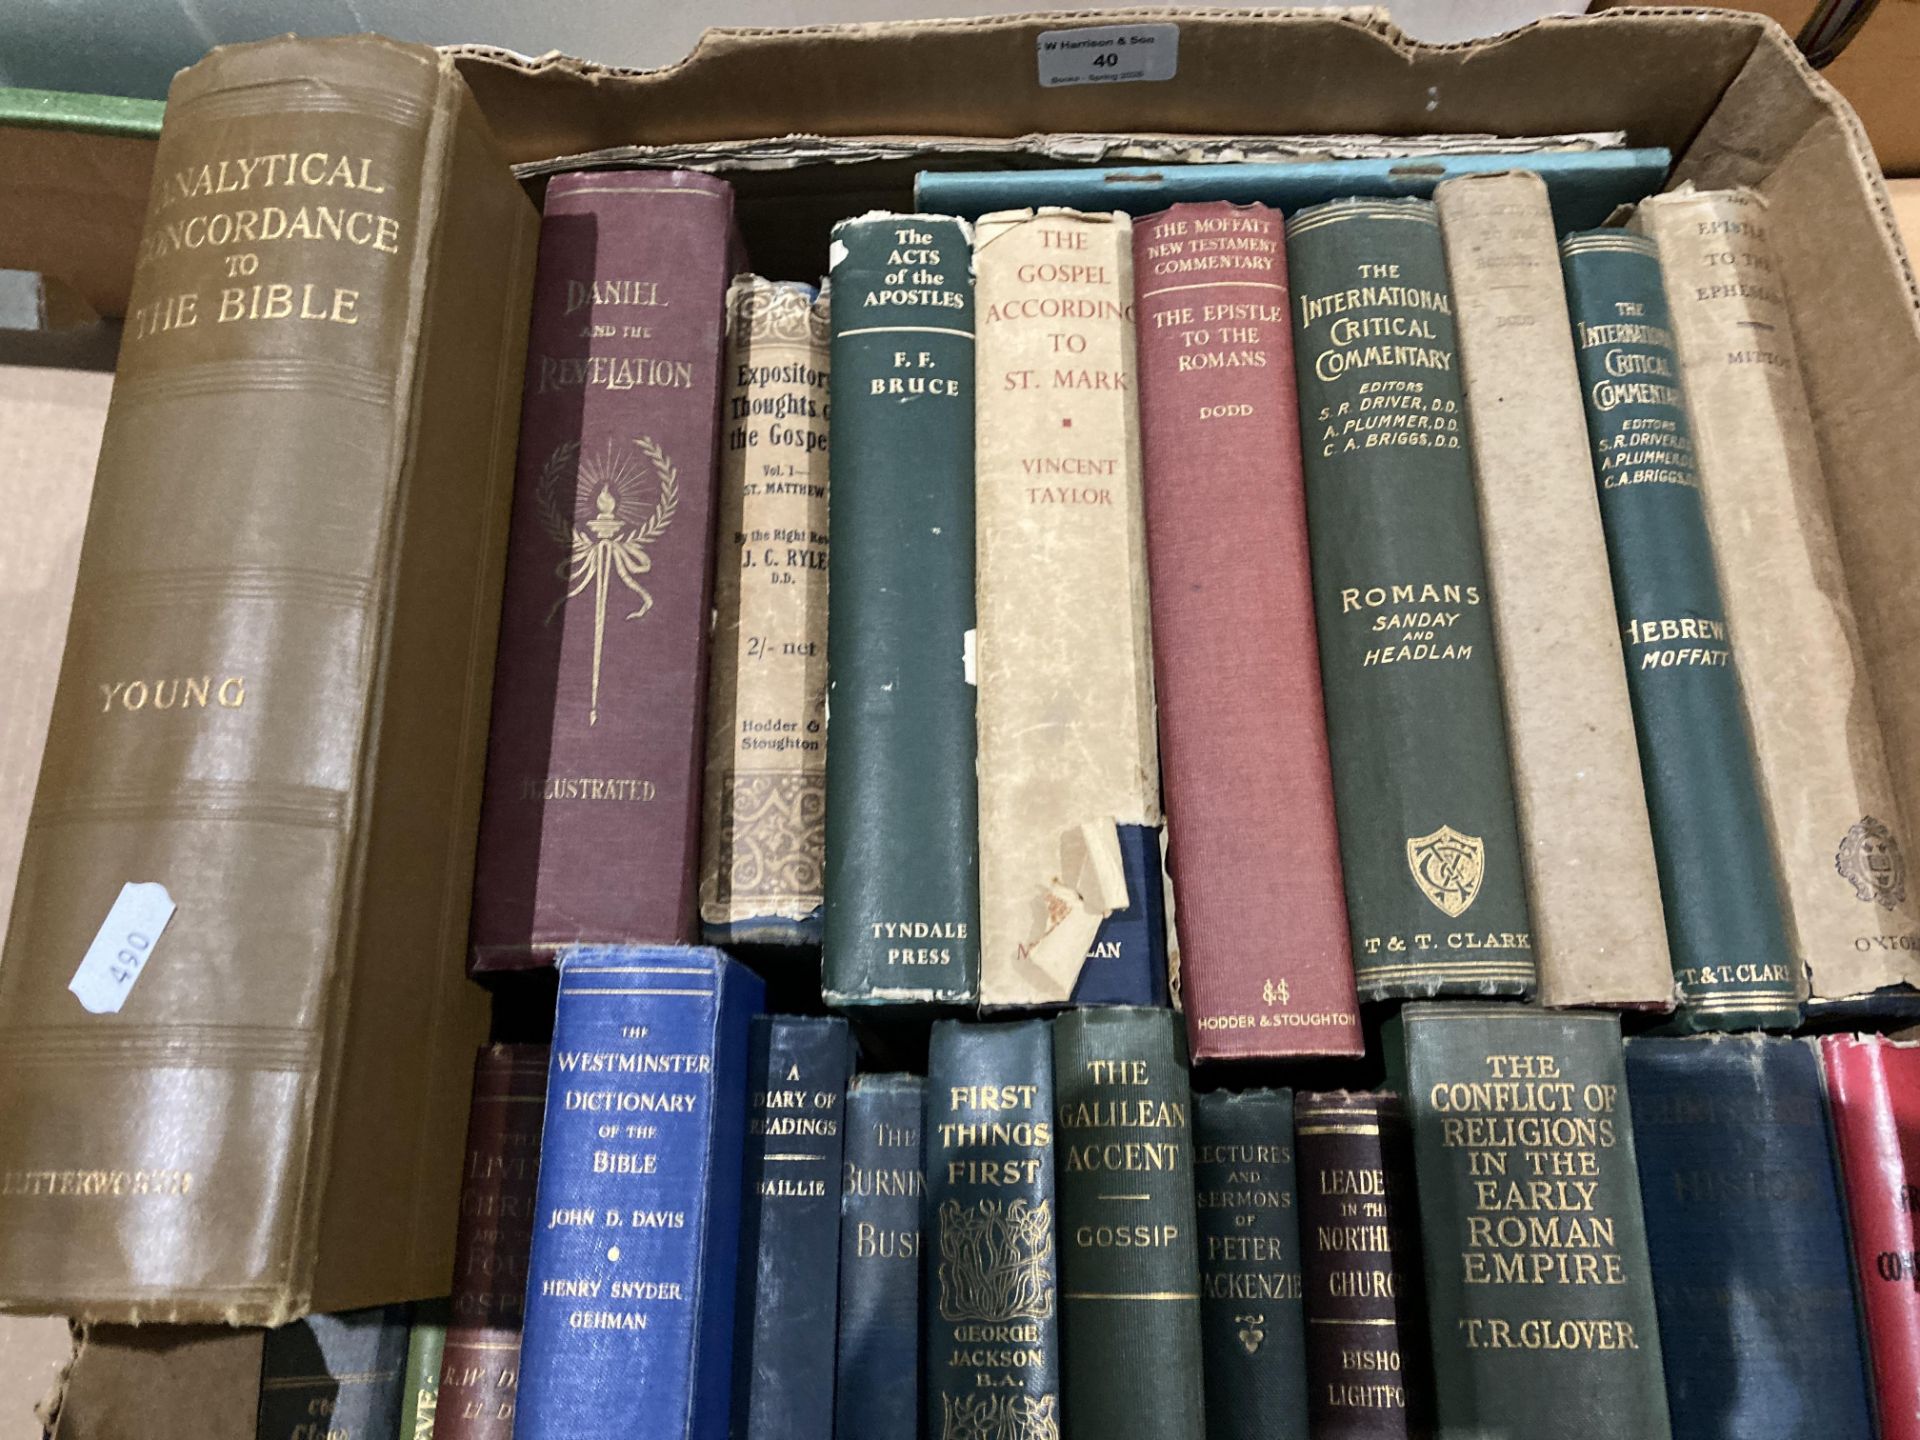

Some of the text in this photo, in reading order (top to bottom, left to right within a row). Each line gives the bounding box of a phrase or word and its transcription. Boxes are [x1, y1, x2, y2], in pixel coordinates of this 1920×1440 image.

[1045, 42, 1057, 50] W
[1061, 38, 1113, 49] Harrison
[1117, 36, 1126, 45] &
[1093, 53, 1118, 67] 40
[895, 228, 934, 245] The
[1154, 218, 1270, 239] THE MOFFATT
[1038, 229, 1088, 250] THE
[1148, 238, 1277, 259] NEW TESTAMENT
[225, 253, 259, 278] TO
[887, 249, 940, 265] ACTS
[1155, 256, 1274, 274] COMMENTARY
[1705, 253, 1735, 266] TO
[884, 269, 944, 286] of the
[1018, 264, 1111, 284] GOSPEL
[1358, 264, 1400, 278] THE
[564, 280, 668, 315] DANIEL
[863, 289, 965, 310] APOSTLES
[1300, 287, 1452, 329] INTERNATIONAL
[137, 284, 359, 340] THE BIBLE
[1153, 304, 1282, 328] THE EPISTLE
[1615, 302, 1645, 316] THE
[580, 325, 652, 338] AND THE
[1182, 328, 1259, 347] TO THE
[1331, 317, 1437, 346] CRITICAL
[1048, 334, 1086, 353] TO
[894, 351, 936, 369] F. F.
[1179, 352, 1266, 372] ROMANS
[1316, 346, 1452, 381] COMMENTARY
[1605, 349, 1672, 376] CRITICAL
[539, 355, 693, 395] REVELATION
[1004, 369, 1129, 391] ST. MARK
[870, 377, 959, 397] BRUCE
[1359, 381, 1423, 394] EDITORS
[731, 394, 816, 420] Thoughts
[1200, 404, 1253, 419] DODD
[1622, 419, 1676, 431] EDITORS
[730, 424, 828, 453] the Gospe
[763, 464, 784, 477] Vol.
[1022, 458, 1117, 475] VINCENT
[744, 484, 825, 499] ST. MATTHEW
[1026, 487, 1112, 505] TAYLOR
[752, 529, 770, 541] the
[773, 529, 806, 543] Right
[743, 551, 756, 568] J.
[764, 550, 779, 567] C.
[771, 571, 796, 585] D.D.
[1341, 584, 1480, 613] ROMANS
[1372, 612, 1461, 631] SANDAY
[1403, 631, 1434, 641] AND
[783, 640, 817, 656] net
[1363, 644, 1473, 667] HEADLAM
[1641, 649, 1728, 670] MOFFATT
[101, 676, 246, 712] YOUNG
[742, 719, 820, 733] Hodder &
[741, 737, 819, 752] Stoughton
[872, 922, 968, 940] TYNDALE
[1388, 936, 1406, 951] &
[1415, 934, 1438, 949] T.
[1447, 933, 1531, 949] CLARK
[109, 932, 149, 984] 490
[888, 948, 951, 965] PRESS
[622, 1026, 648, 1038] THE
[1198, 1013, 1355, 1030] HODDER & STOUGHTON
[558, 1051, 712, 1073] WESTMINSTER
[787, 1063, 800, 1081] A
[1487, 1055, 1560, 1079] THE
[1088, 1060, 1149, 1086] THE
[565, 1090, 696, 1112] DICTIONARY
[814, 1091, 837, 1109] OF
[950, 1085, 1038, 1112] FIRST
[1431, 1083, 1618, 1113] CONFLICT OF
[1059, 1100, 1185, 1128] GALILEAN
[599, 1125, 657, 1139] OF THE
[873, 1122, 918, 1147] THE
[938, 1122, 1050, 1149] THINGS
[1441, 1118, 1617, 1148] RELIGIONS
[592, 1151, 657, 1174] BIBLE
[1065, 1143, 1179, 1172] ACCENT
[1469, 1152, 1600, 1176] IN THE
[844, 1159, 928, 1200] BURNIN
[947, 1160, 1040, 1187] FIRST
[1227, 1171, 1260, 1184] AND
[1321, 1169, 1385, 1195] LEADE
[1198, 1191, 1292, 1209] SERMONS
[1474, 1181, 1599, 1211] EARLY
[548, 1208, 685, 1229] JOHN D. DAVIS
[1342, 1203, 1357, 1217] IN
[1235, 1215, 1256, 1227] OF
[857, 1221, 920, 1258] BUS
[1077, 1225, 1178, 1248] GOSSIP
[1467, 1216, 1615, 1249] ROMAN
[1208, 1237, 1282, 1261] PETER
[1461, 1253, 1627, 1285] EMPIRE
[542, 1279, 683, 1300] HENRY SNYDER
[1201, 1273, 1302, 1300] ACKENZIE
[569, 1311, 648, 1329] GEHMAN
[954, 1324, 1039, 1343] GEORGE
[949, 1348, 1044, 1367] JACKSON
[1343, 1350, 1400, 1371] BISHO
[1328, 1384, 1405, 1408] LIGHTFO
